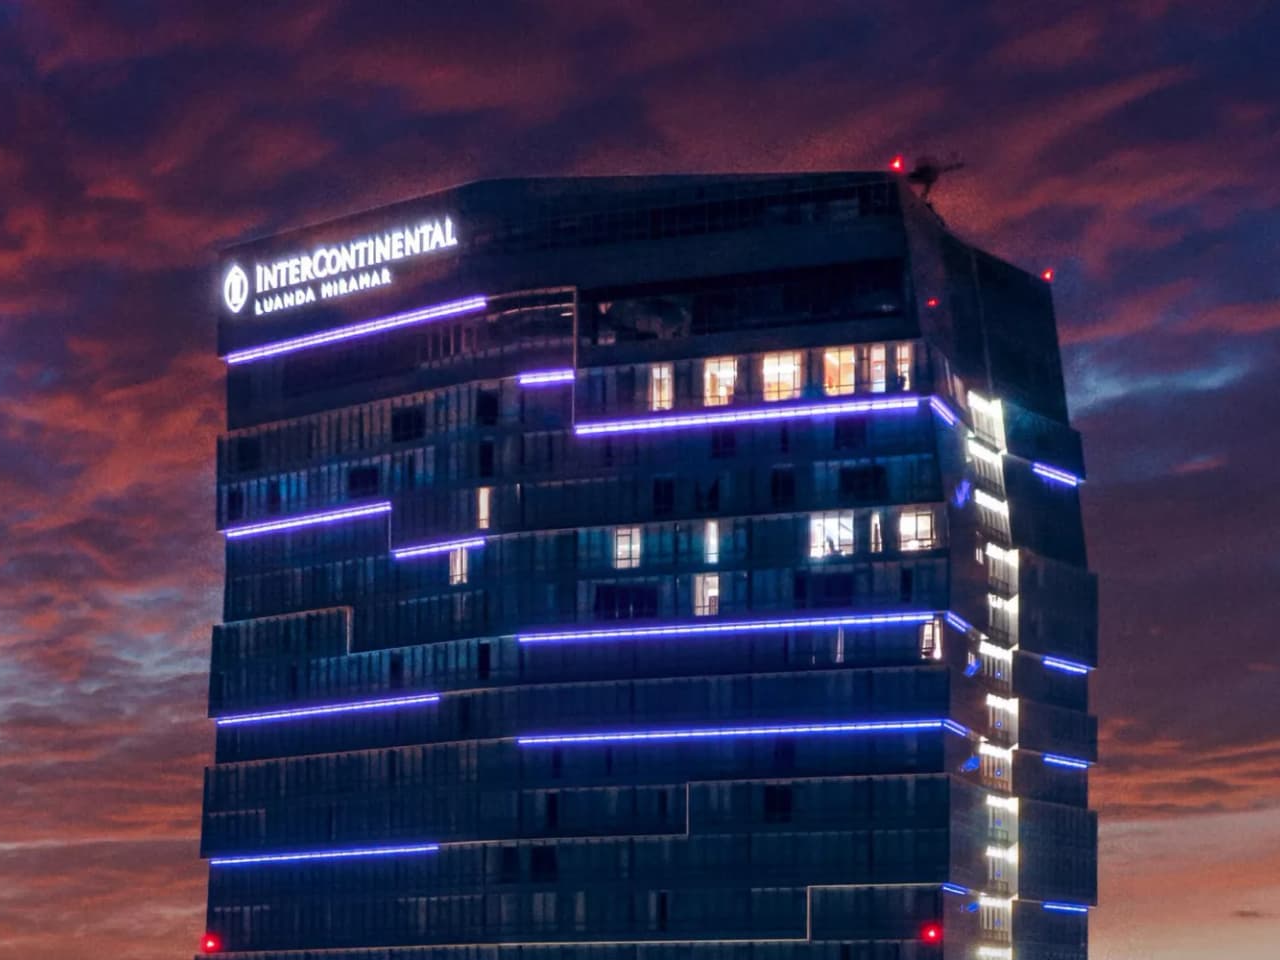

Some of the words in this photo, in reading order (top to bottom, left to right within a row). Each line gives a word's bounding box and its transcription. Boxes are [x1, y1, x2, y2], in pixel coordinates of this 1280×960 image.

[255, 217, 457, 293] INTERCONTINENTAL
[255, 287, 316, 315] LUANDA
[321, 268, 392, 298] MIRAMAR
